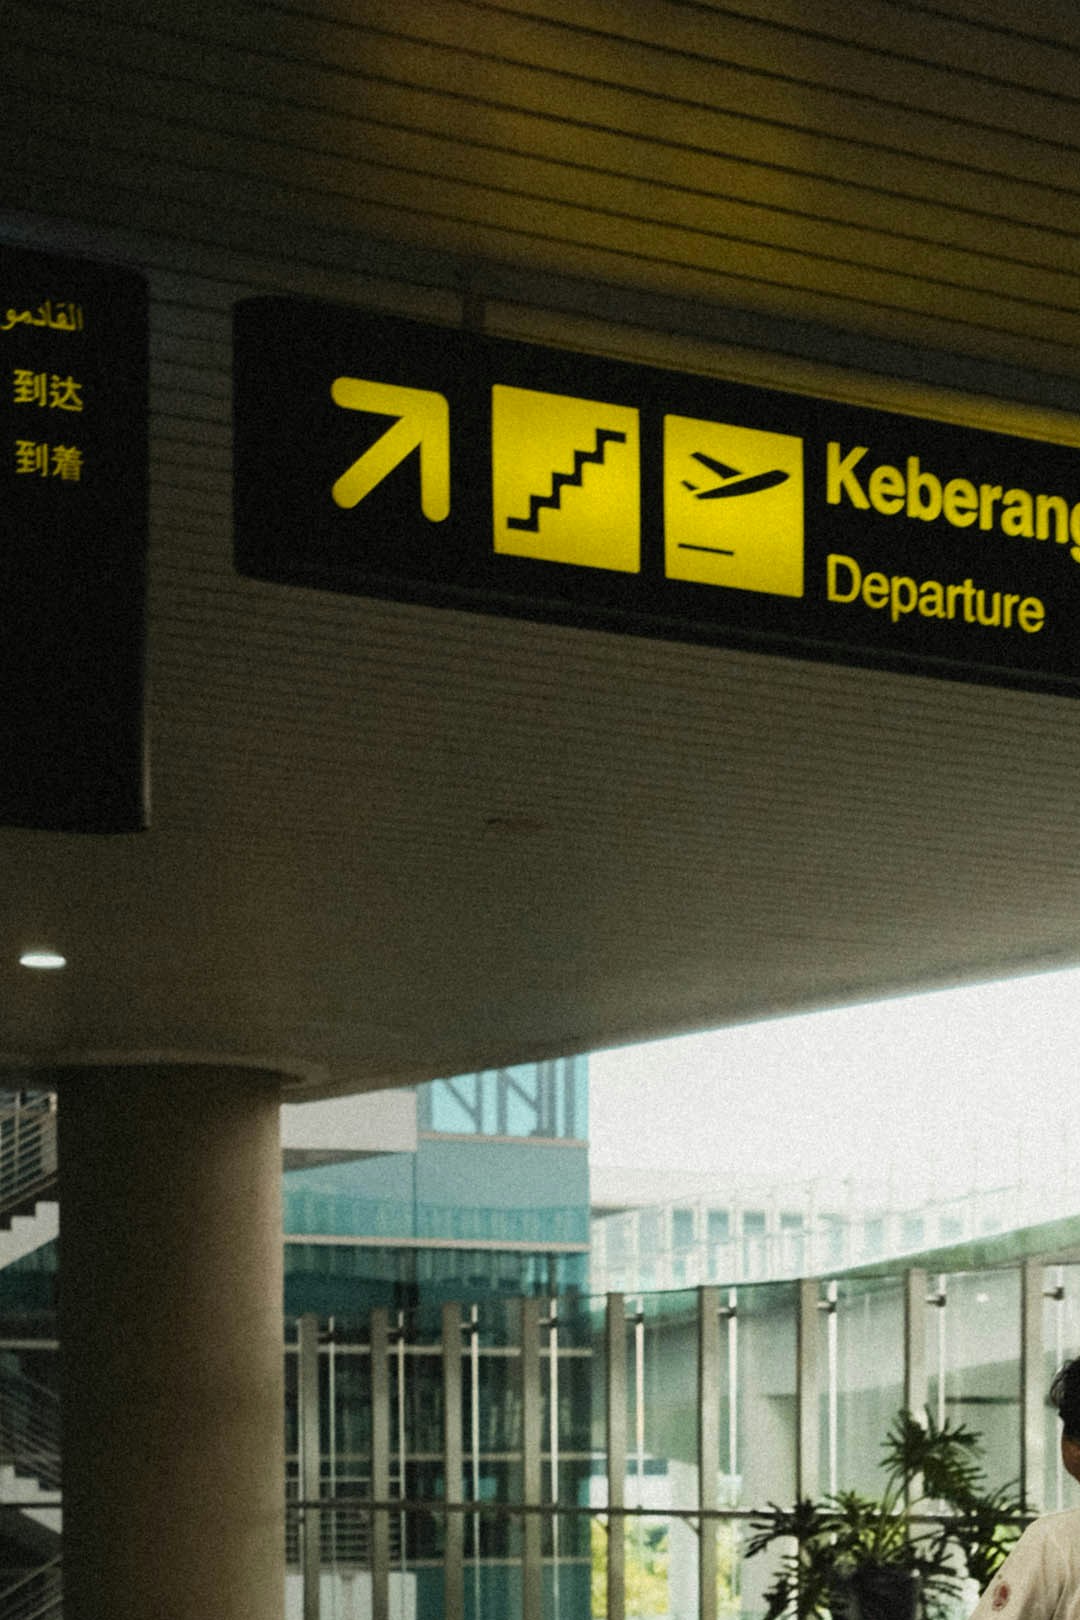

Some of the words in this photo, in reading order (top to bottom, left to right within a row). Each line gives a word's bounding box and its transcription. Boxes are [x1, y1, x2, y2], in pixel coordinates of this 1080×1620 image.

[13, 368, 83, 412] 到达
[15, 439, 83, 481] 到着
[825, 552, 1046, 634] Departure
